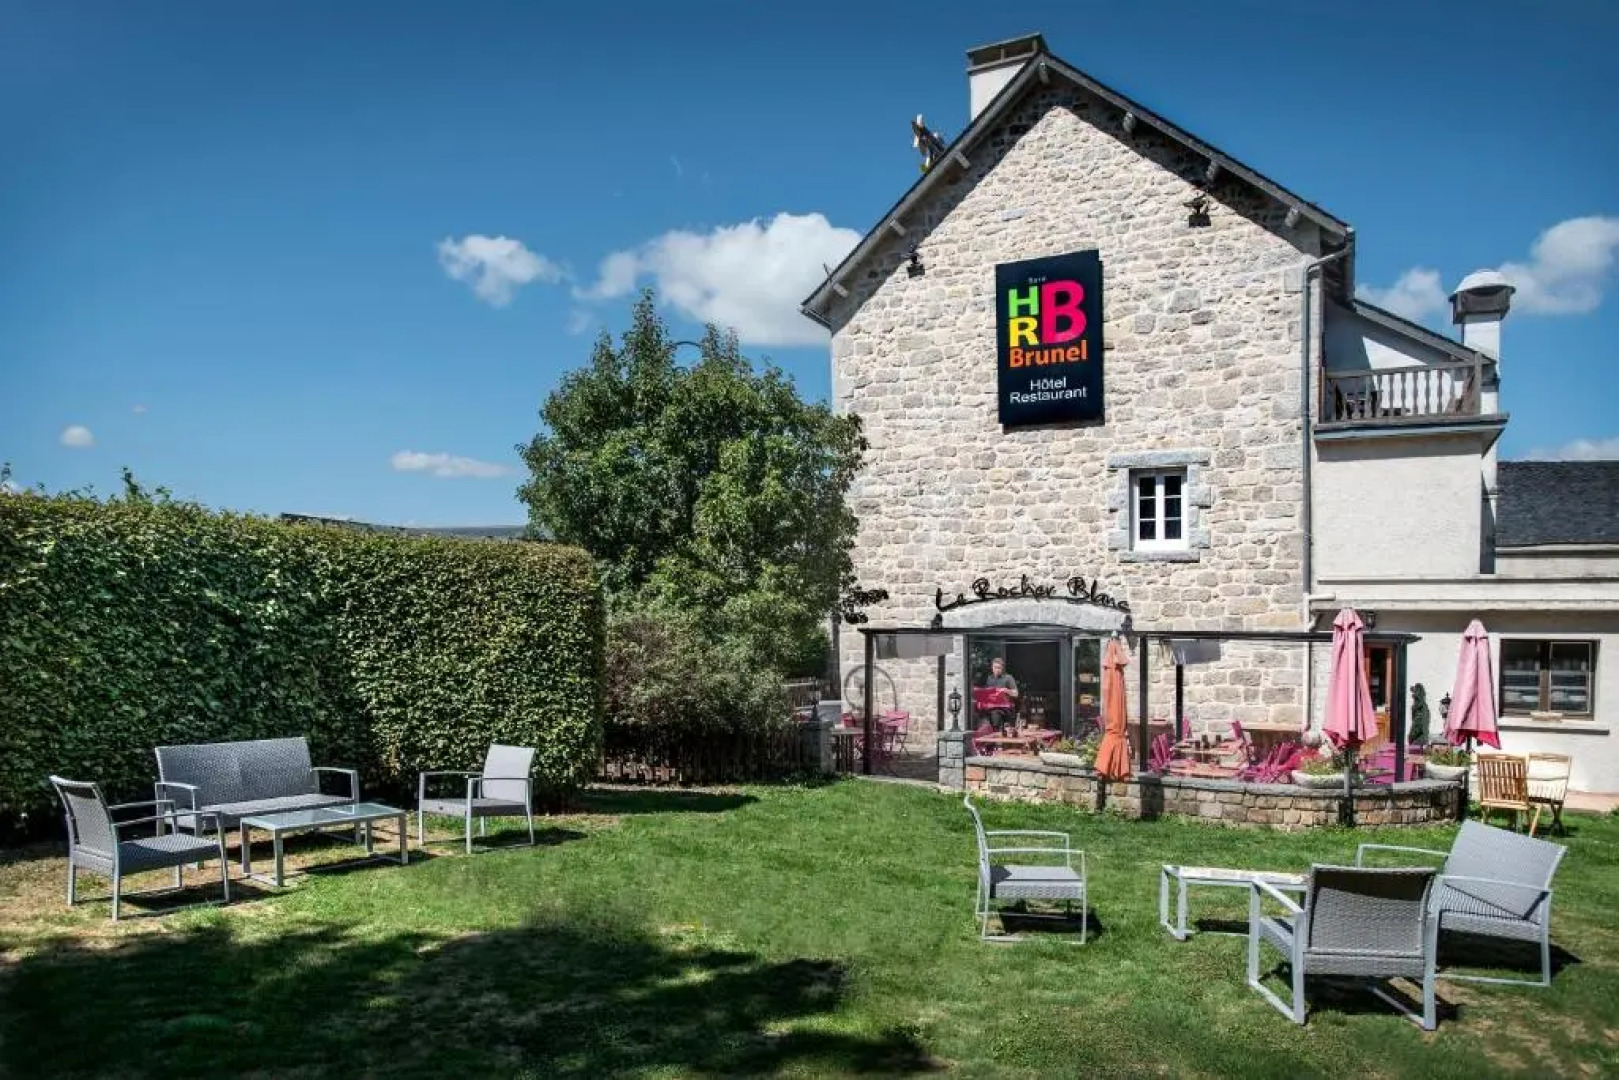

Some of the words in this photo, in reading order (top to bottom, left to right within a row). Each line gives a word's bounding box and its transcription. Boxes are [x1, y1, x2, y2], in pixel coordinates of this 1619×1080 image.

[1008, 285, 1039, 318] H
[1041, 279, 1087, 345] B
[1009, 317, 1039, 347] R
[1009, 340, 1088, 368] Brunel
[1009, 386, 1088, 404] Restaurant
[1030, 376, 1067, 391] Hôtel
